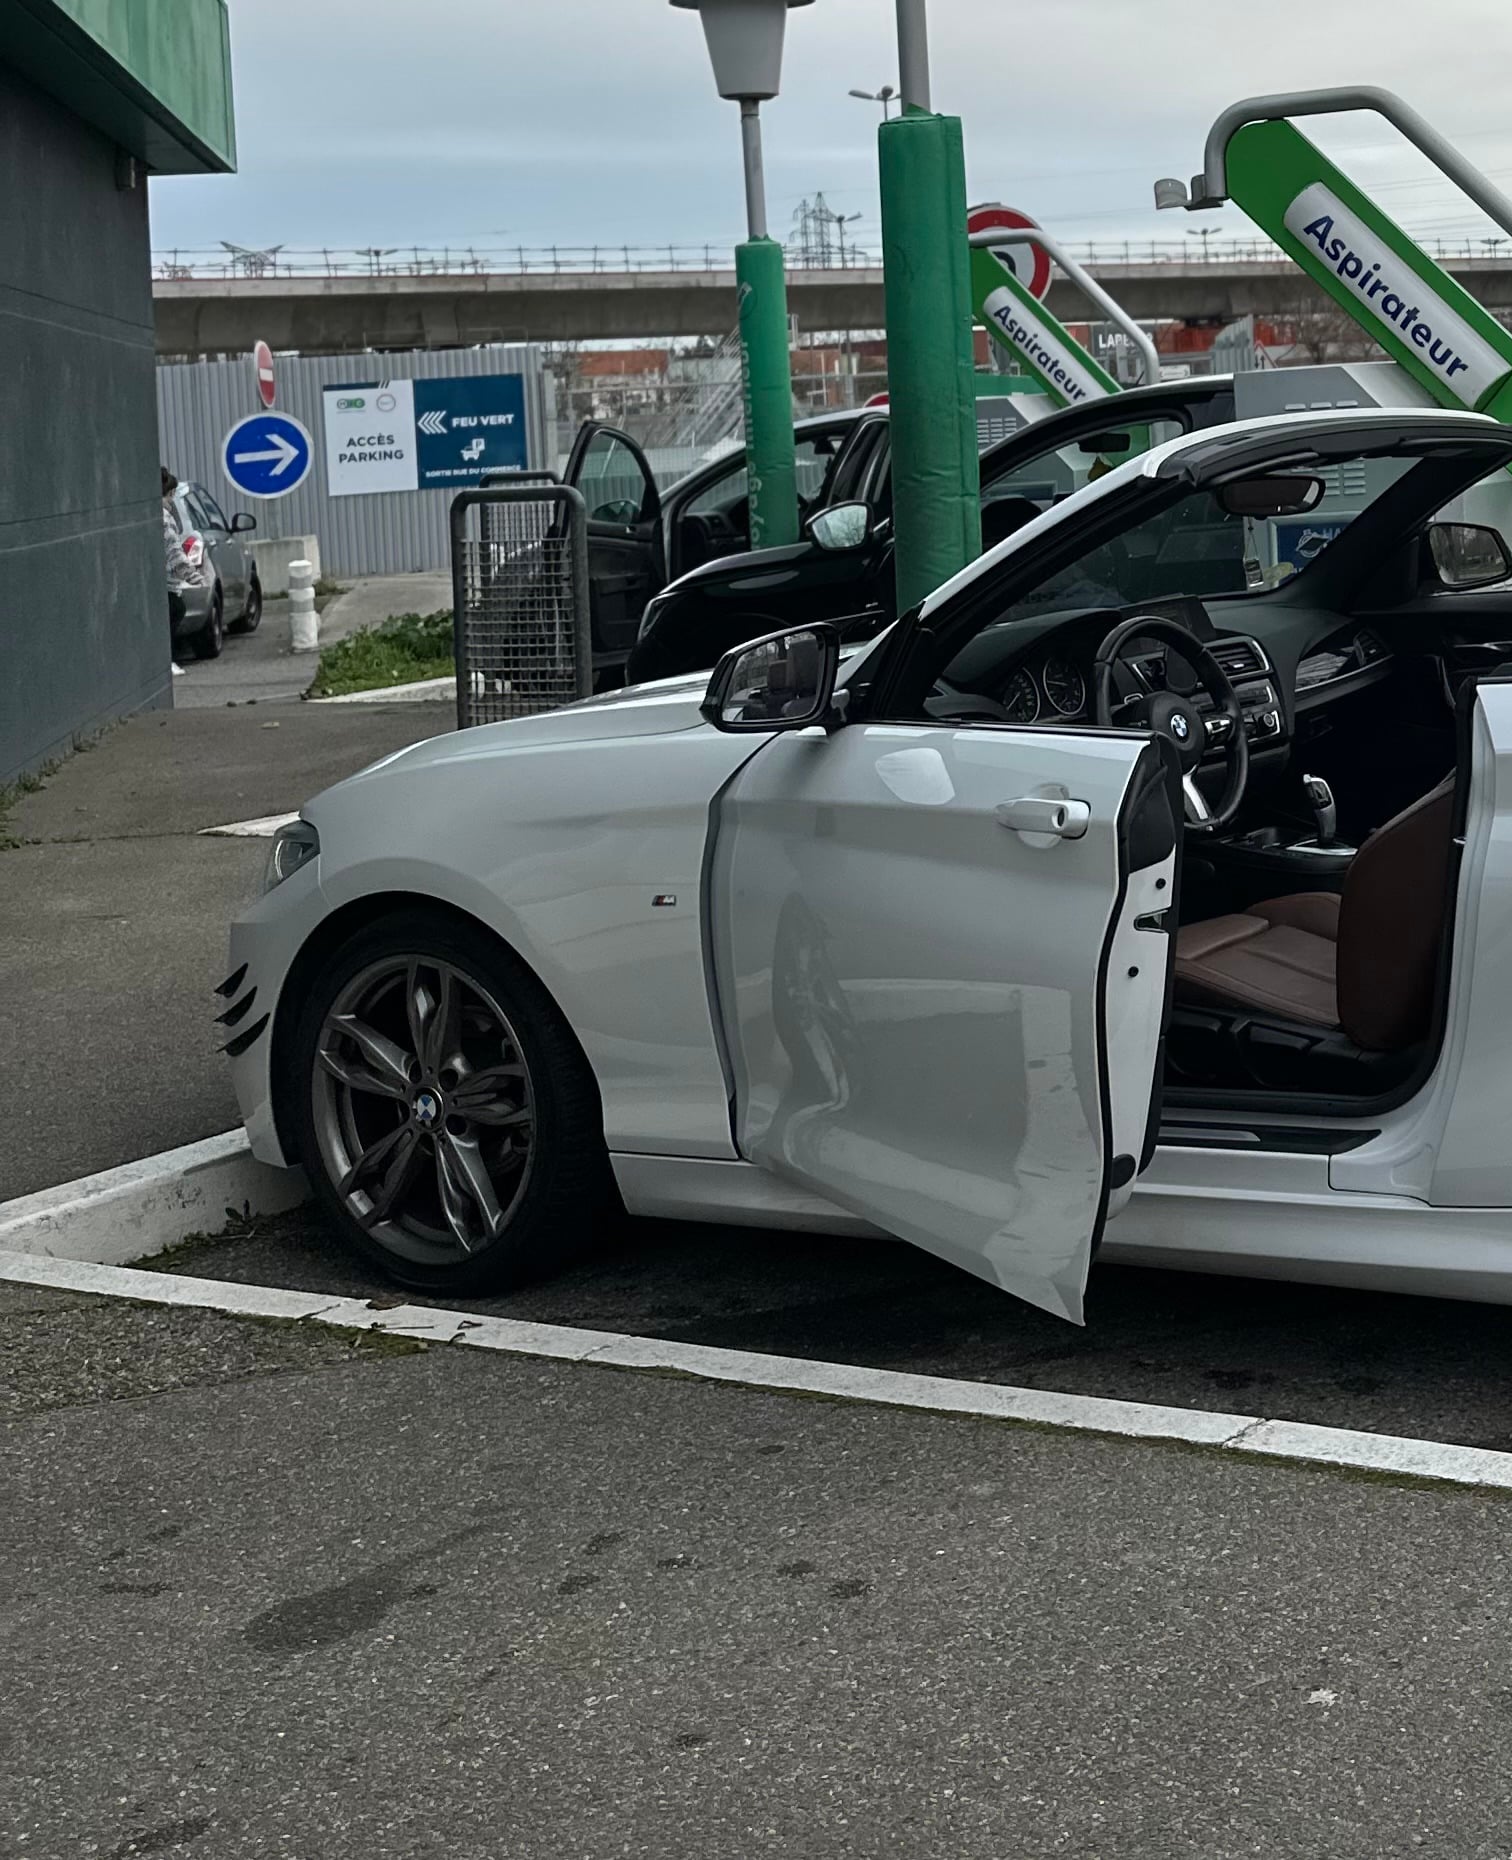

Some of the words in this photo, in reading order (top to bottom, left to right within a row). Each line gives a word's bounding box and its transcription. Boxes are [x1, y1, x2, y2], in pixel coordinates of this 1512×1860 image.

[1303, 215, 1469, 377] Aspirateur
[994, 304, 1086, 400] Aspirateur
[452, 417, 478, 428] FEU
[480, 414, 515, 426] VERT
[346, 433, 395, 448] ACCÈS
[338, 450, 405, 464] PARKING
